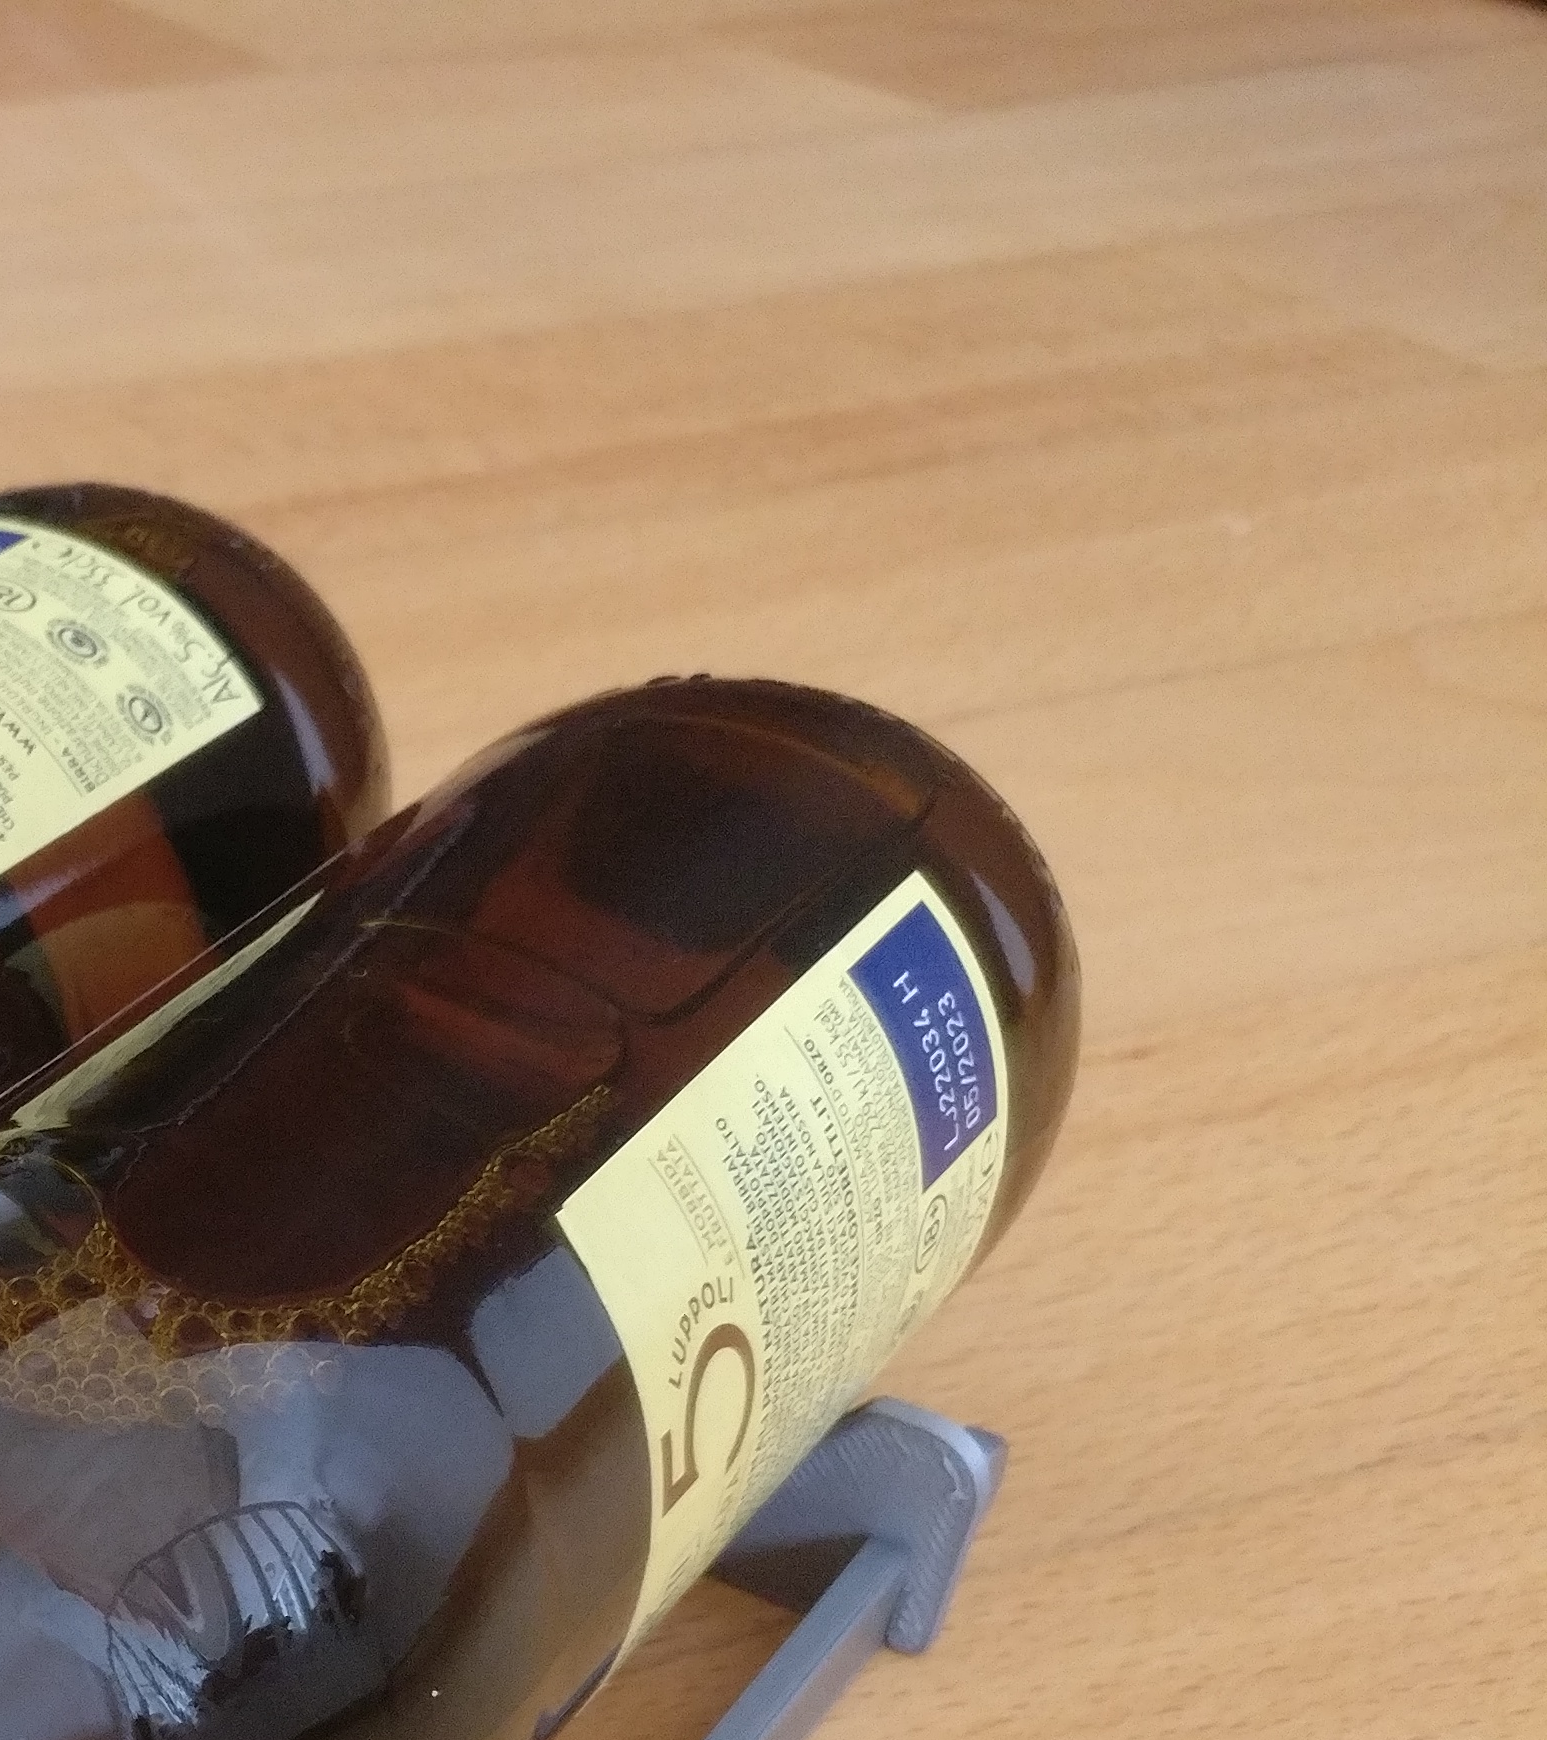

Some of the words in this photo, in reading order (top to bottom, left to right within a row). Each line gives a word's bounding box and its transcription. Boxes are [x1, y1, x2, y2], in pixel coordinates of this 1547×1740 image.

[58, 745, 97, 794] BIRRA
[892, 972, 919, 1004] H
[833, 1041, 854, 1069] 55
[937, 991, 980, 1130] 05/2023
[713, 1114, 753, 1175] MALTO
[753, 1072, 799, 1152] INTENSO.
[776, 1085, 816, 1158] NOSTRA
[837, 1101, 862, 1161] MALTO
[859, 1101, 880, 1136] 229
[751, 1098, 803, 1201] STAGIONATI
[793, 1152, 818, 1214] GUSTO
[653, 1147, 716, 1251] MORBIDA
[662, 1137, 727, 1248] FRUTTATA
[722, 1152, 755, 1215] BIRRAI
[748, 1175, 779, 1246] DOPPIO
[811, 1157, 832, 1215] SULLA
[824, 1162, 842, 1206] SITO
[748, 1142, 797, 1297] CARATTERIZZATA
[750, 1213, 776, 1285] MASTRI
[813, 1214, 825, 1251] DAL
[772, 1244, 789, 1314] CHIARA
[792, 1228, 810, 1292] AMARO
[668, 1276, 734, 1388] LUPPOLI
[661, 1323, 756, 1517] 5
